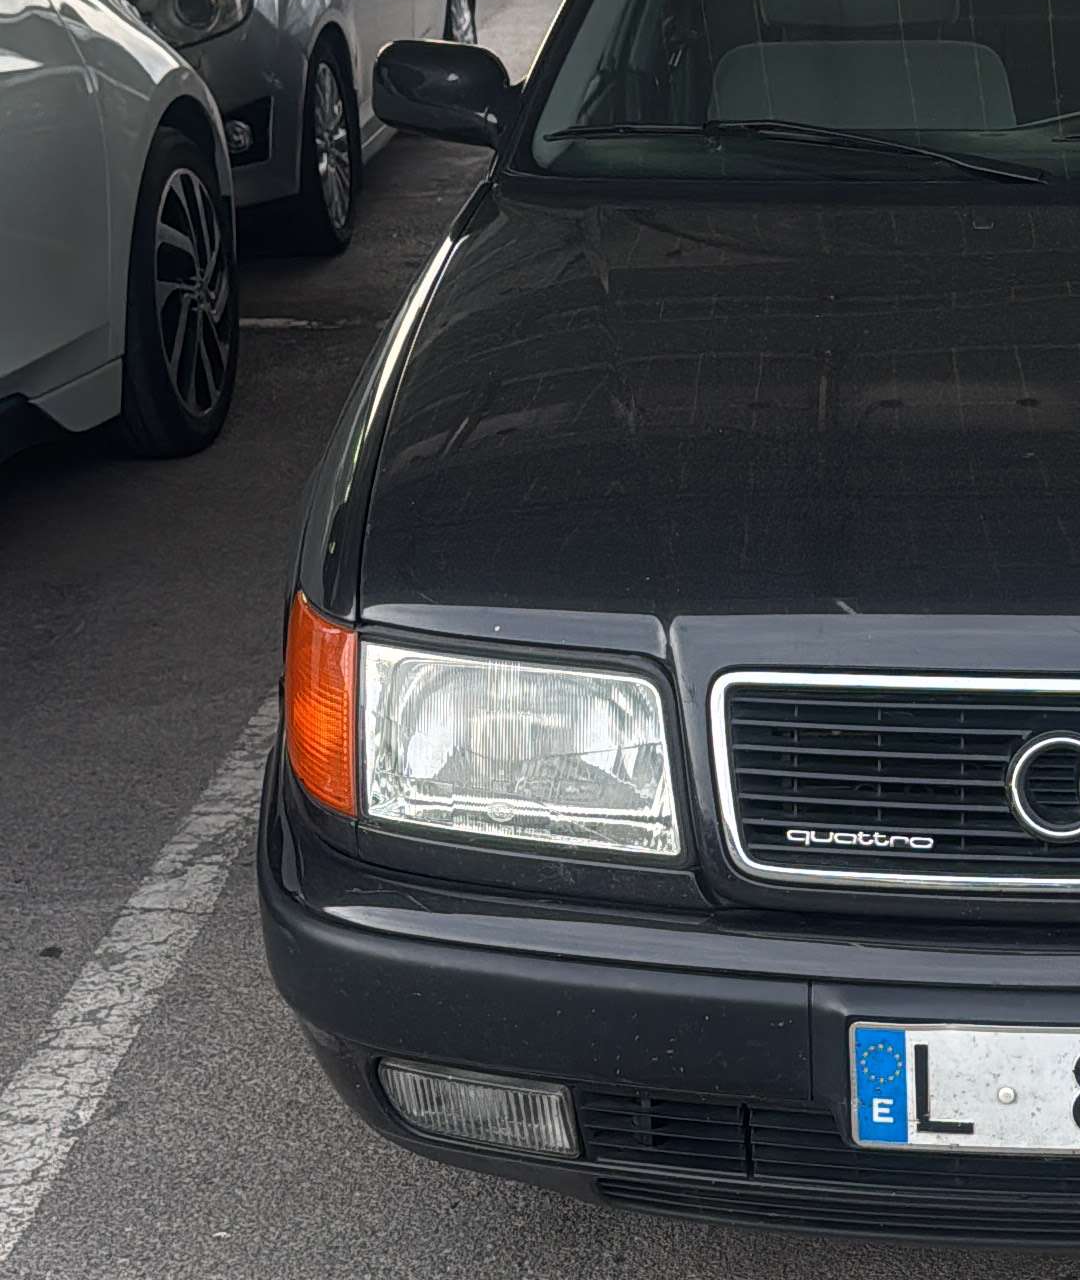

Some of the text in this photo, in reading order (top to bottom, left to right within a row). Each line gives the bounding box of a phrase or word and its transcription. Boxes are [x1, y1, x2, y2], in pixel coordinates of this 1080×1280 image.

[786, 829, 934, 849] quattro
[914, 1043, 975, 1135] L
[872, 1097, 895, 1124] E
